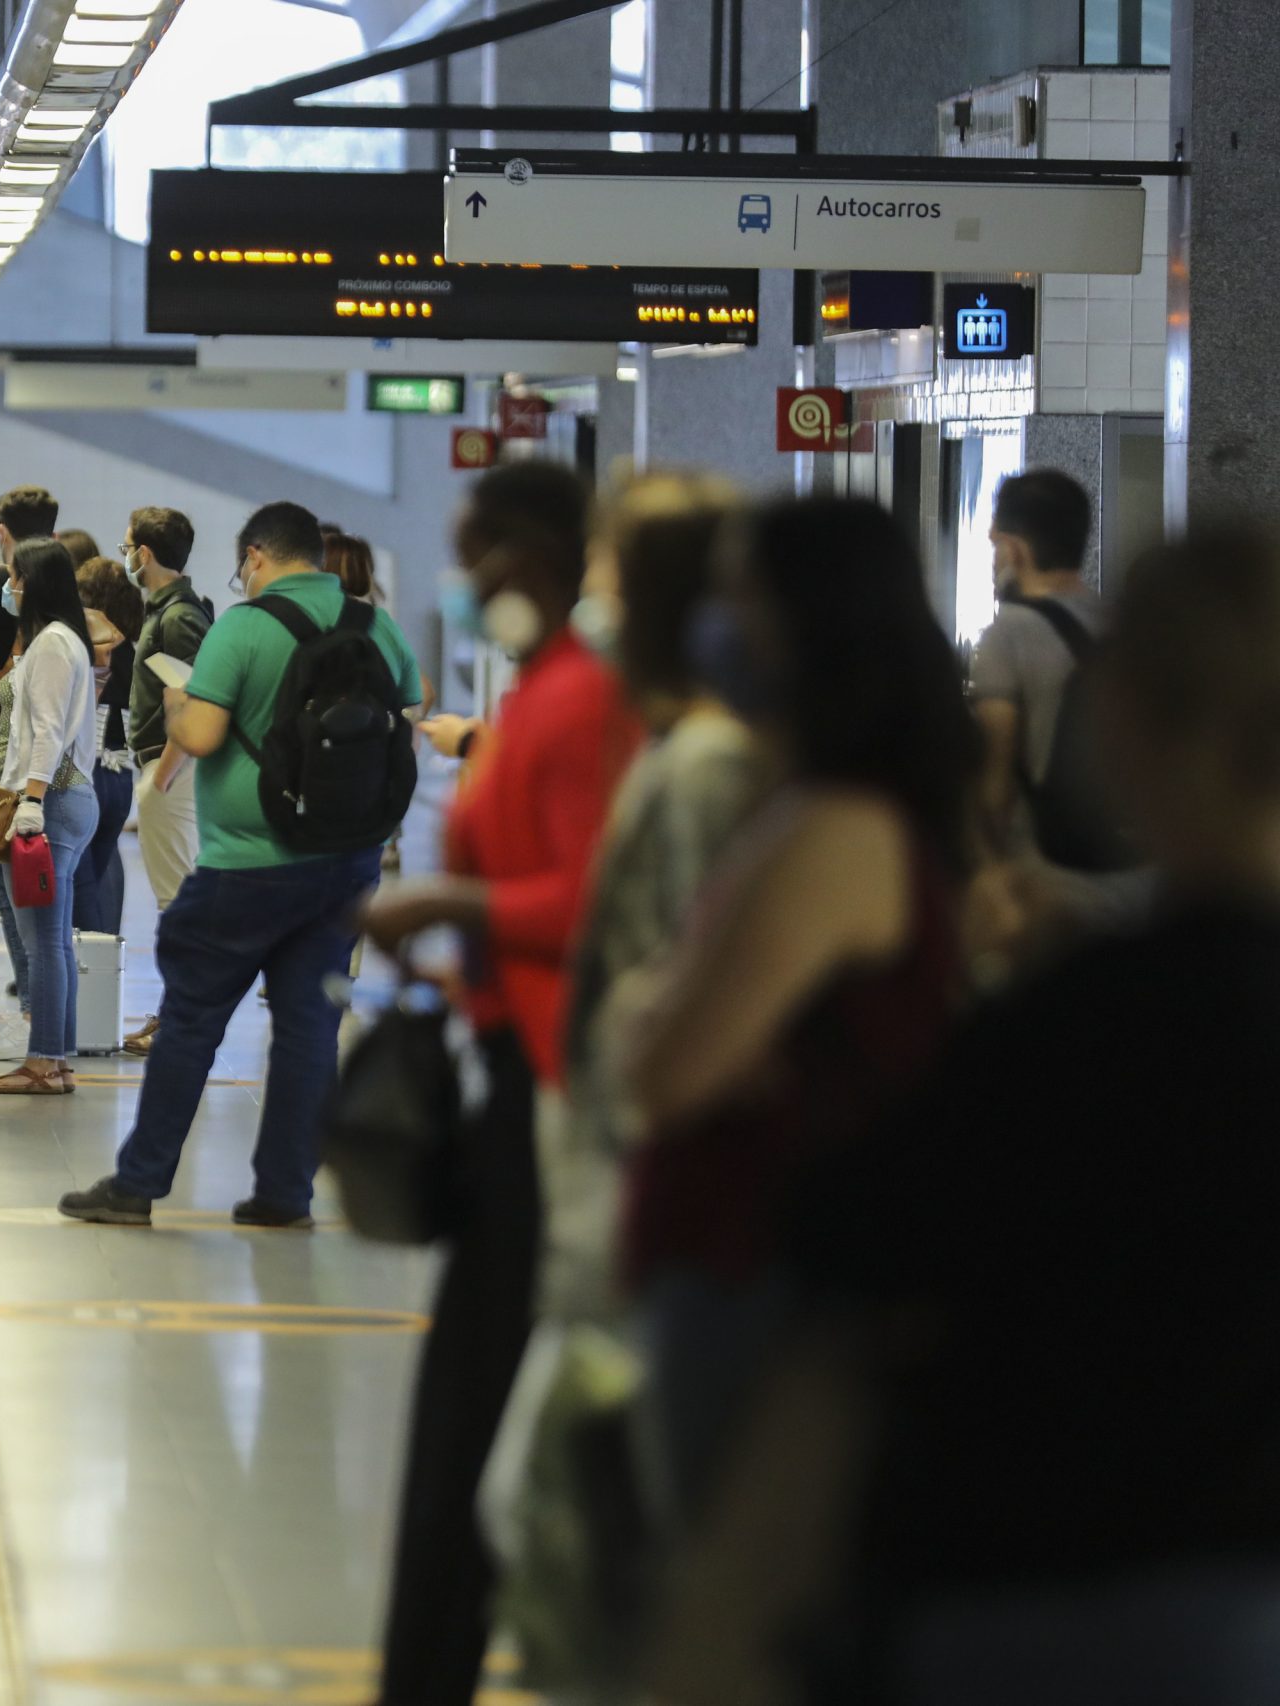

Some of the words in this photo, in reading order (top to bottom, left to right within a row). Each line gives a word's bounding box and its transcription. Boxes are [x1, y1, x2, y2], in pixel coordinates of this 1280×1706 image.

[816, 195, 941, 219] Autocarros
[338, 278, 392, 291] PRÓXIMO
[394, 280, 451, 291] COMBOIO
[632, 283, 669, 294] TEMPO
[670, 284, 685, 295] DE
[687, 285, 729, 295] ESPERA
